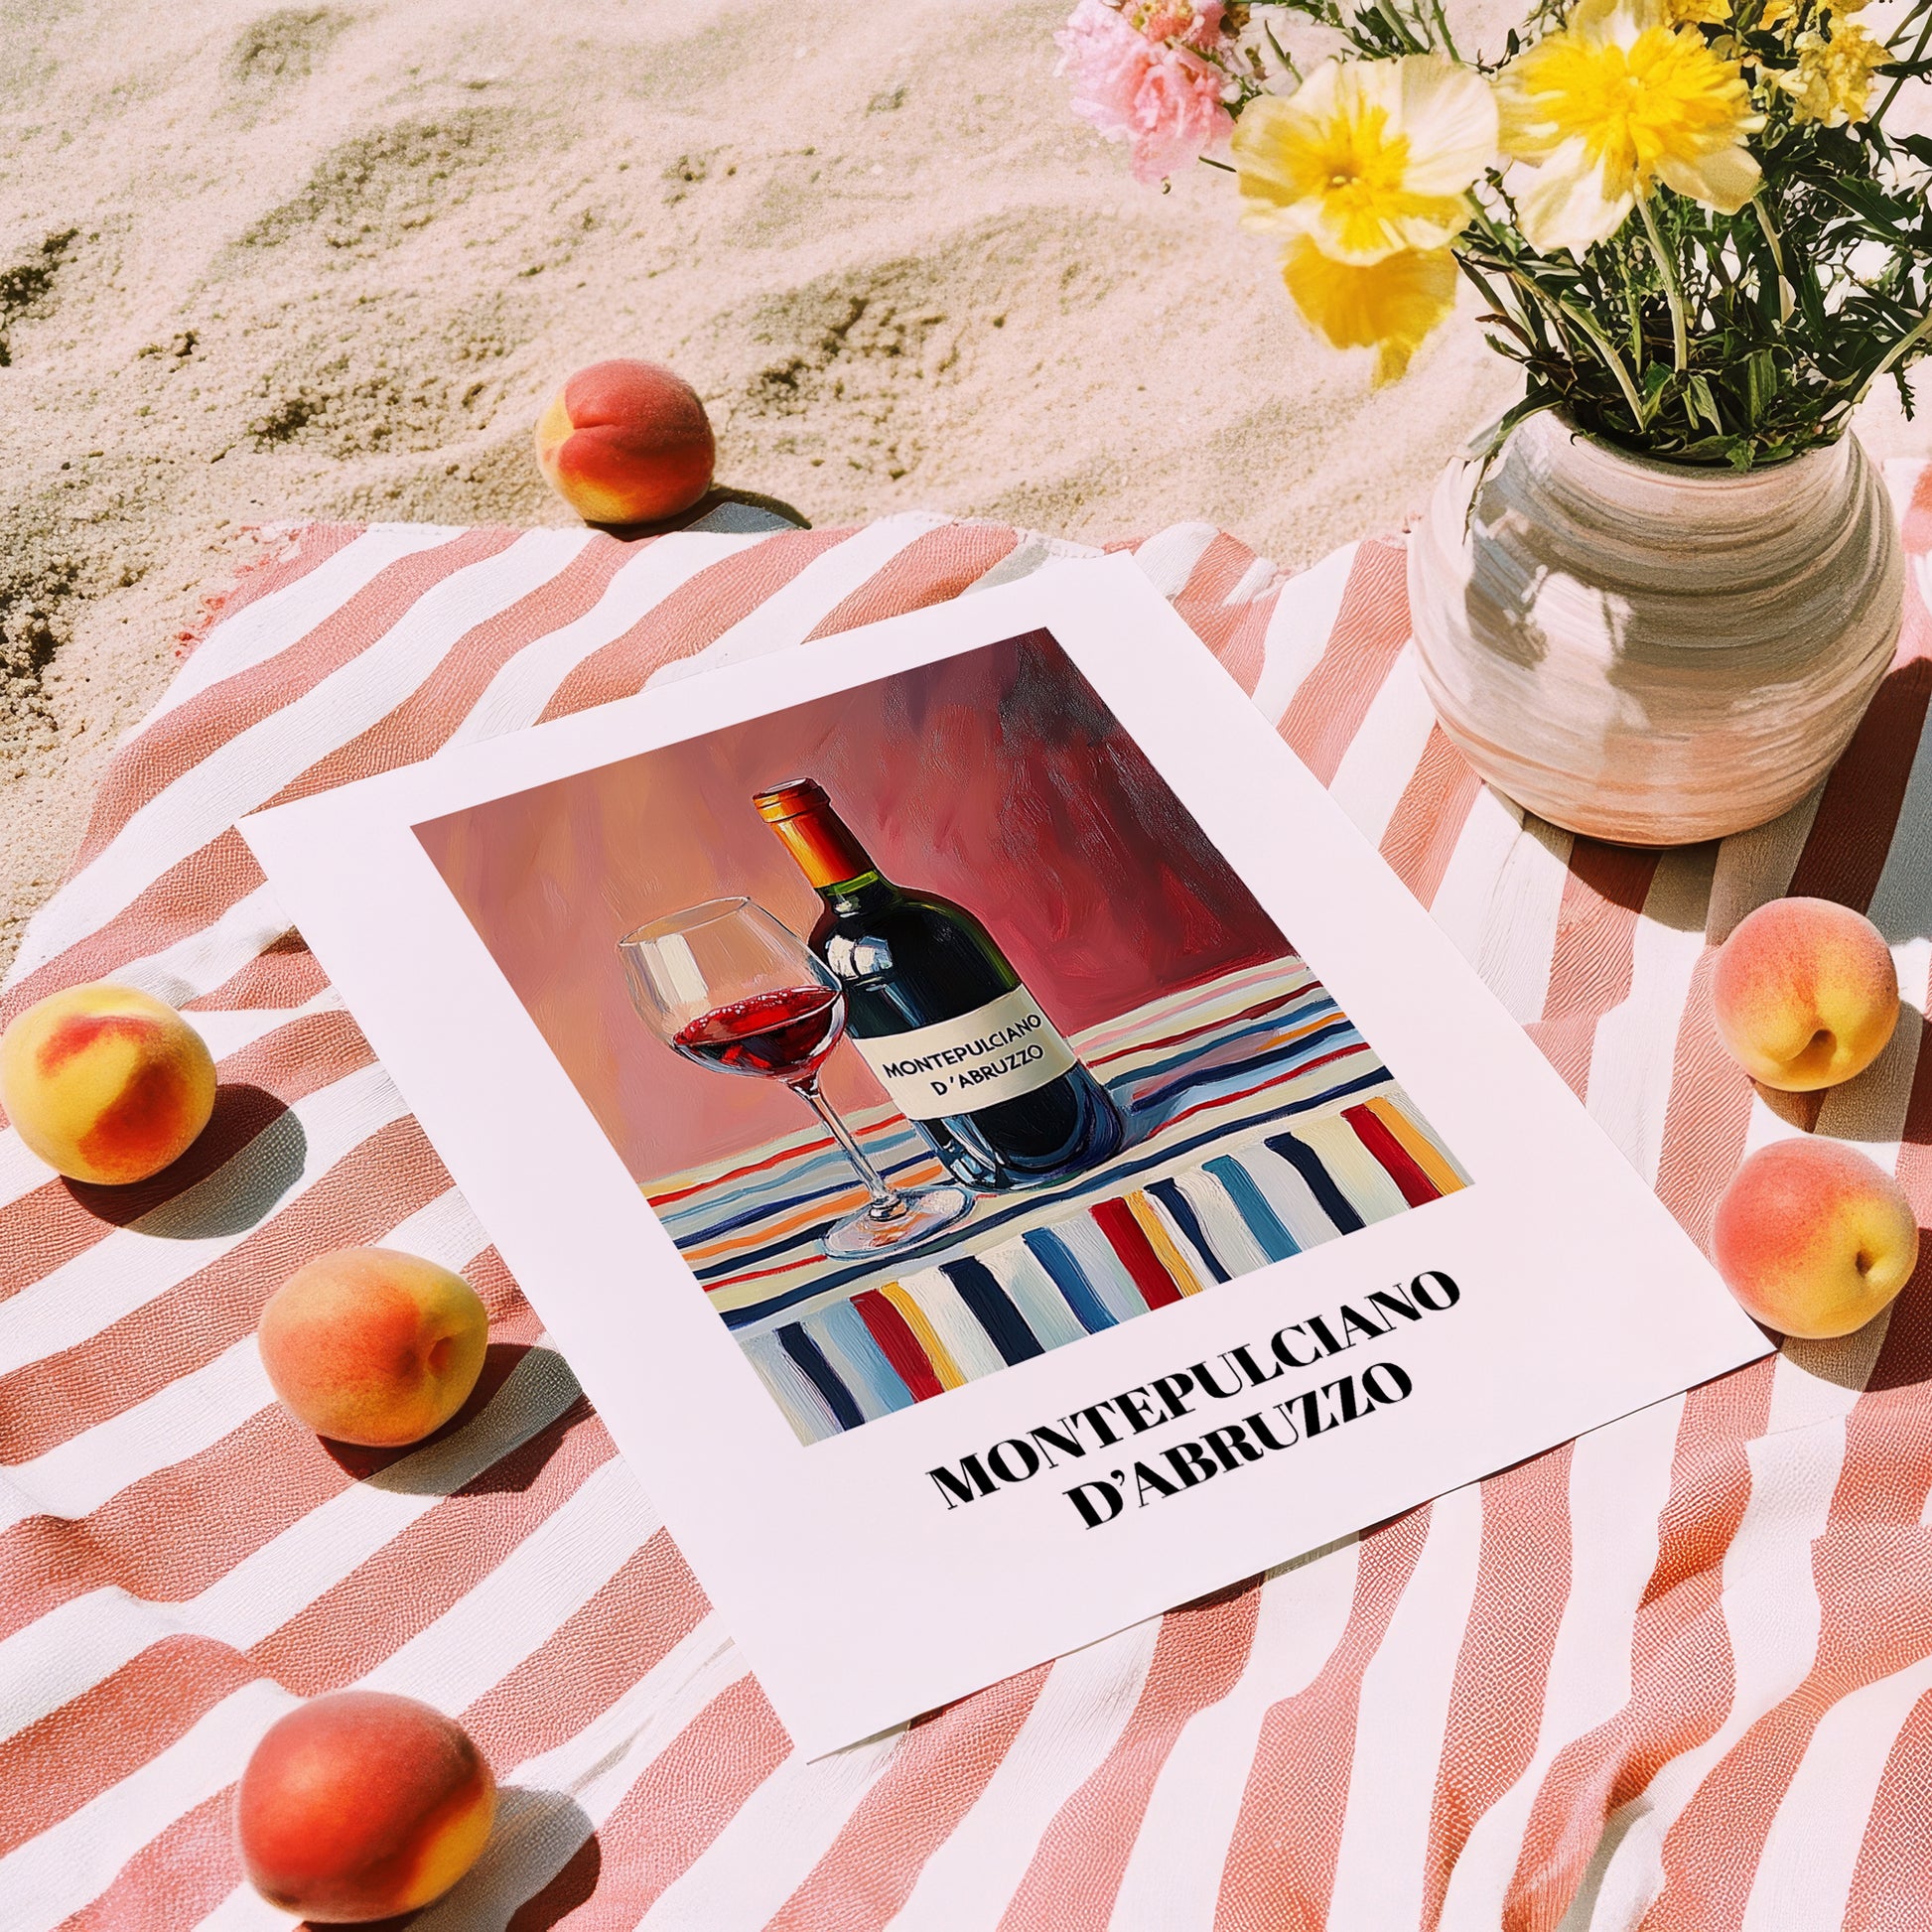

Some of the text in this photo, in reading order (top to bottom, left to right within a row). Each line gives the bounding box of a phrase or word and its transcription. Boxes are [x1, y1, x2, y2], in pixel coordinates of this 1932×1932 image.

[883, 1014, 1041, 1079] MONTEPULCIANO
[925, 1270, 1460, 1511] MONTEPULCIANO
[1061, 1362, 1413, 1531] D’ABRUZZO
